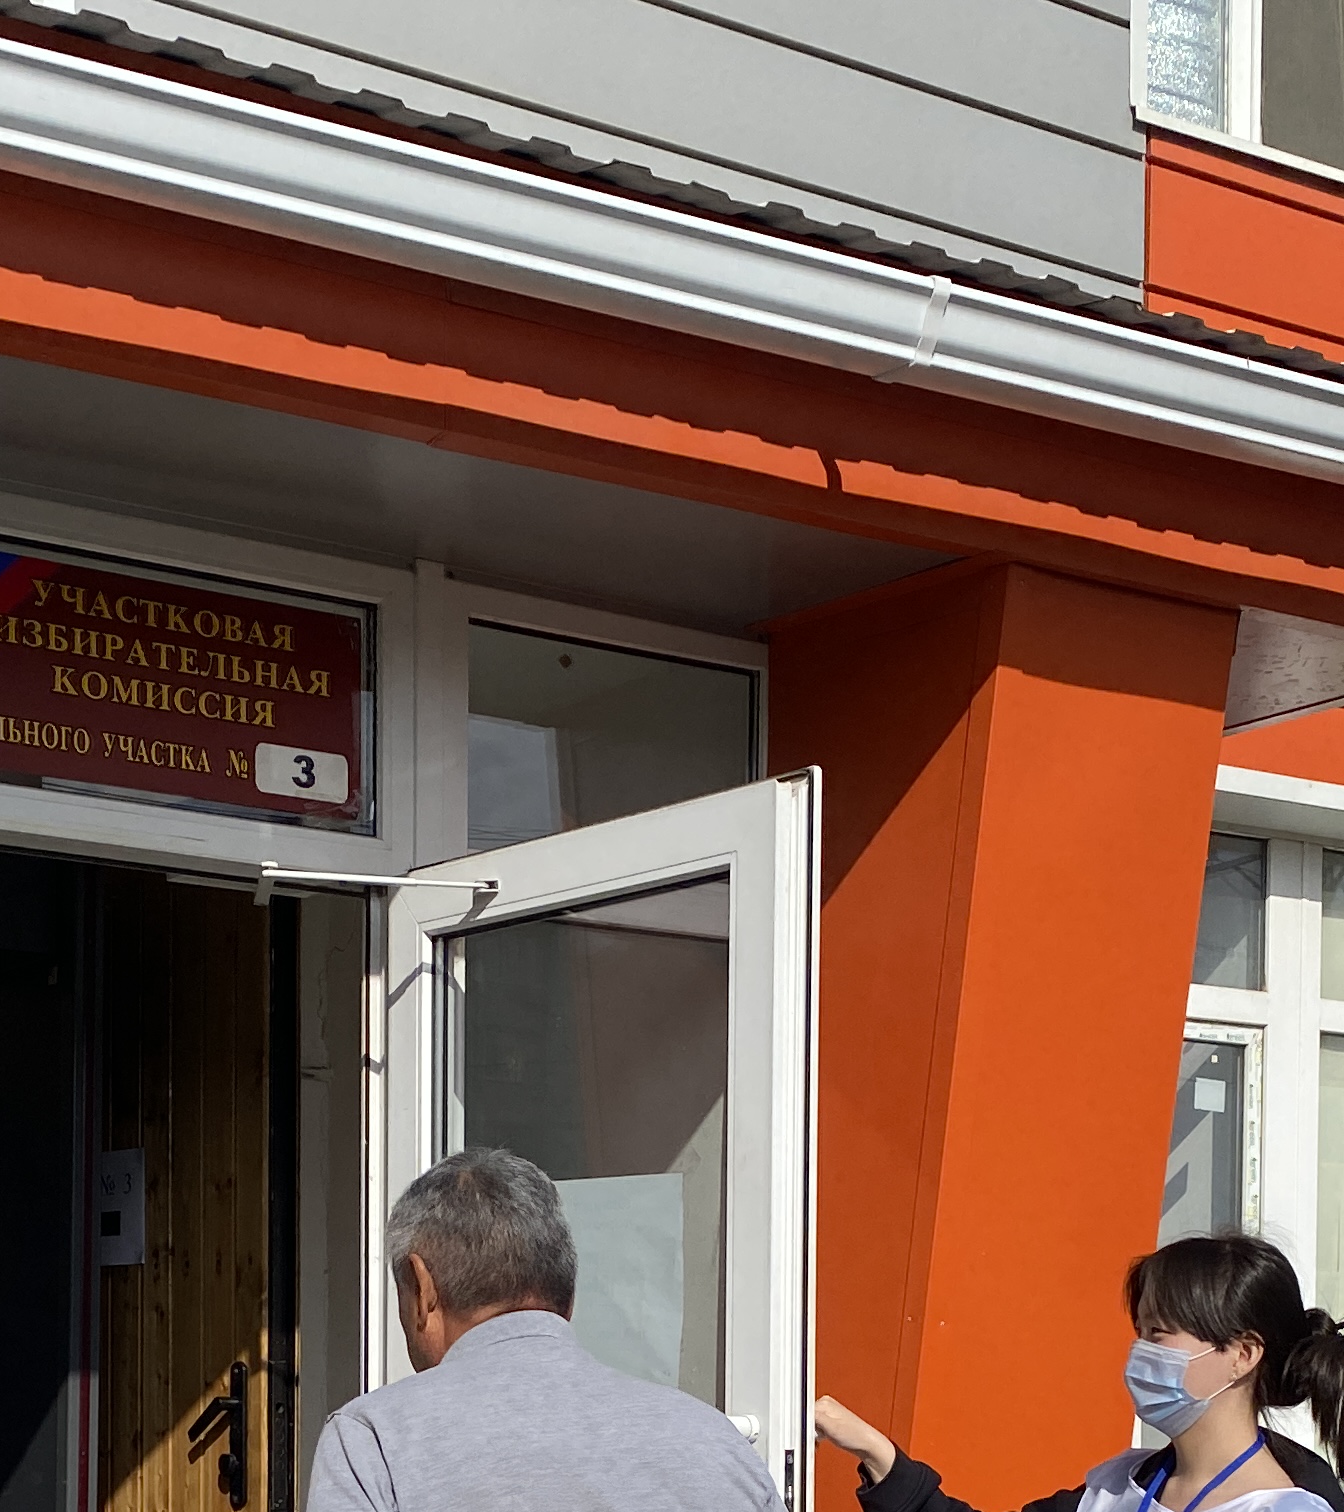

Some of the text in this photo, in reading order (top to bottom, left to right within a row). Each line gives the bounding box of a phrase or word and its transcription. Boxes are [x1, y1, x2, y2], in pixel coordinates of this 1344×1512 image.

[31, 578, 294, 651] УЧАСТКОВАЯ
[52, 665, 276, 728] КОМИССИЯ
[103, 732, 211, 774] УЧАСТКА
[225, 748, 249, 779] №
[292, 754, 316, 789] 3
[124, 1172, 132, 1195] 3
